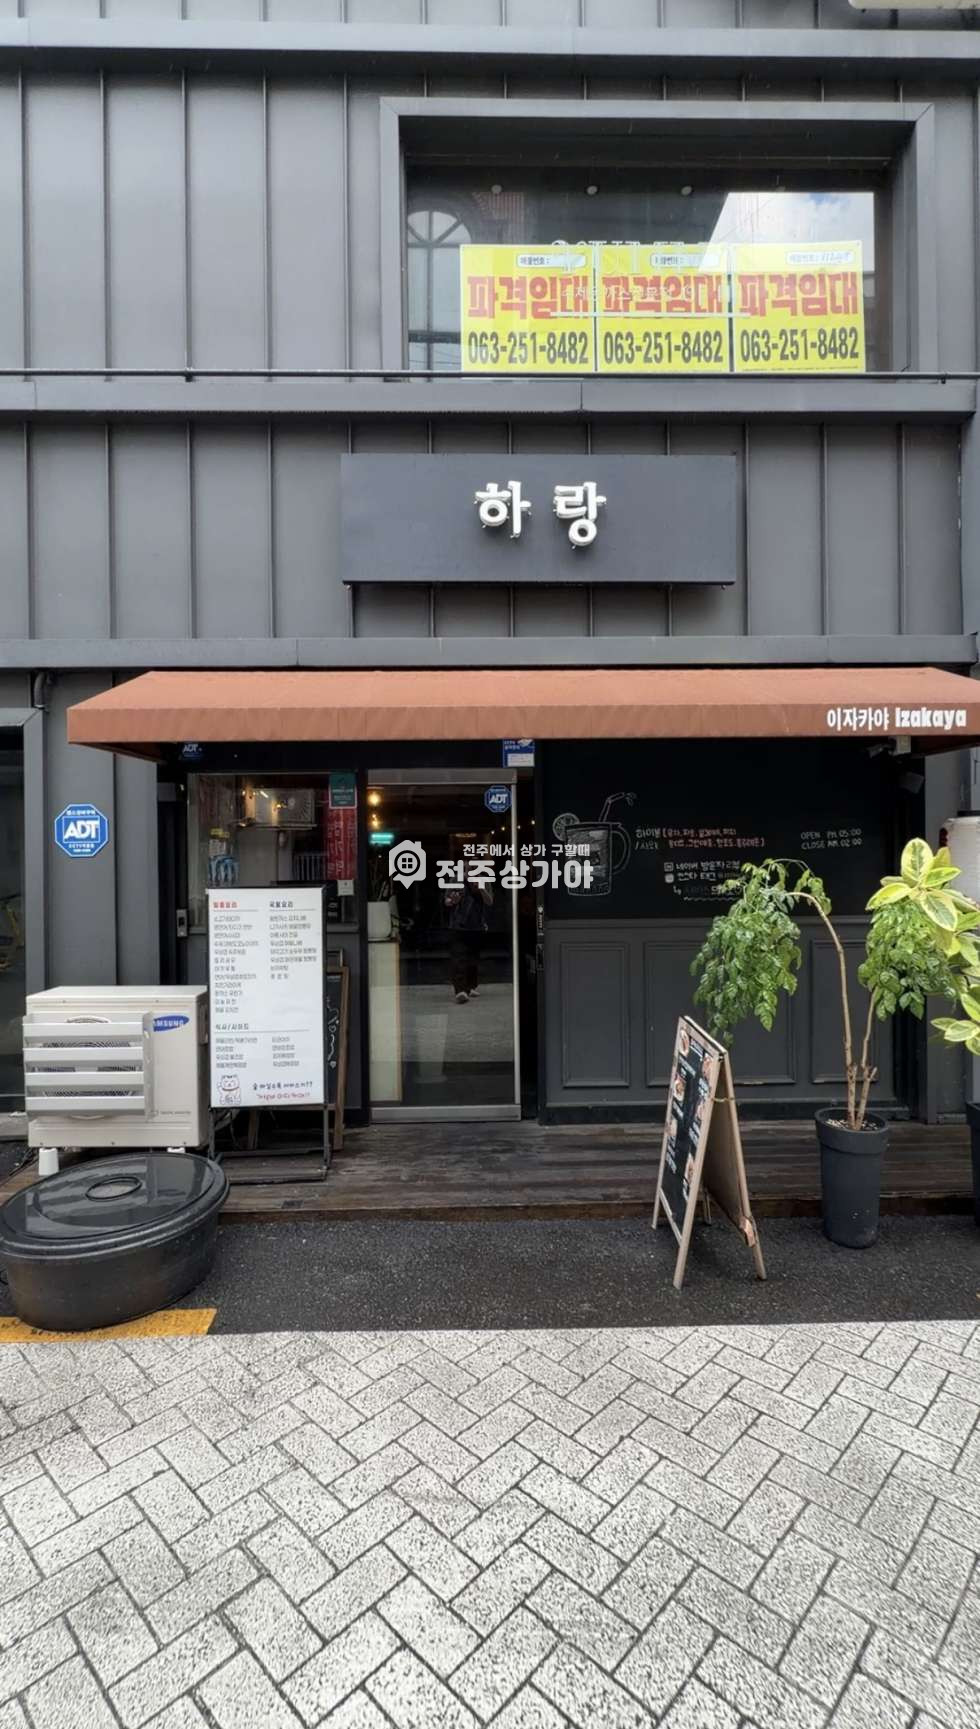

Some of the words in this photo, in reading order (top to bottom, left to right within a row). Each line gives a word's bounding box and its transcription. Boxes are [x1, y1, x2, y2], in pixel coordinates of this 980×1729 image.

[468, 275, 589, 319] 파격임대
[601, 275, 722, 319] 파격임대
[738, 272, 859, 317] 파격임대
[468, 331, 589, 365] 063-251-8482
[603, 331, 723, 364] 063-251-8482
[740, 327, 859, 362] 063-251-8482
[827, 707, 890, 731] 이자카야
[895, 706, 967, 730] Izakaya
[489, 793, 508, 804] ADT
[64, 820, 99, 839] ADT
[800, 831, 820, 840] OPEN
[801, 840, 825, 850] CLOSE
